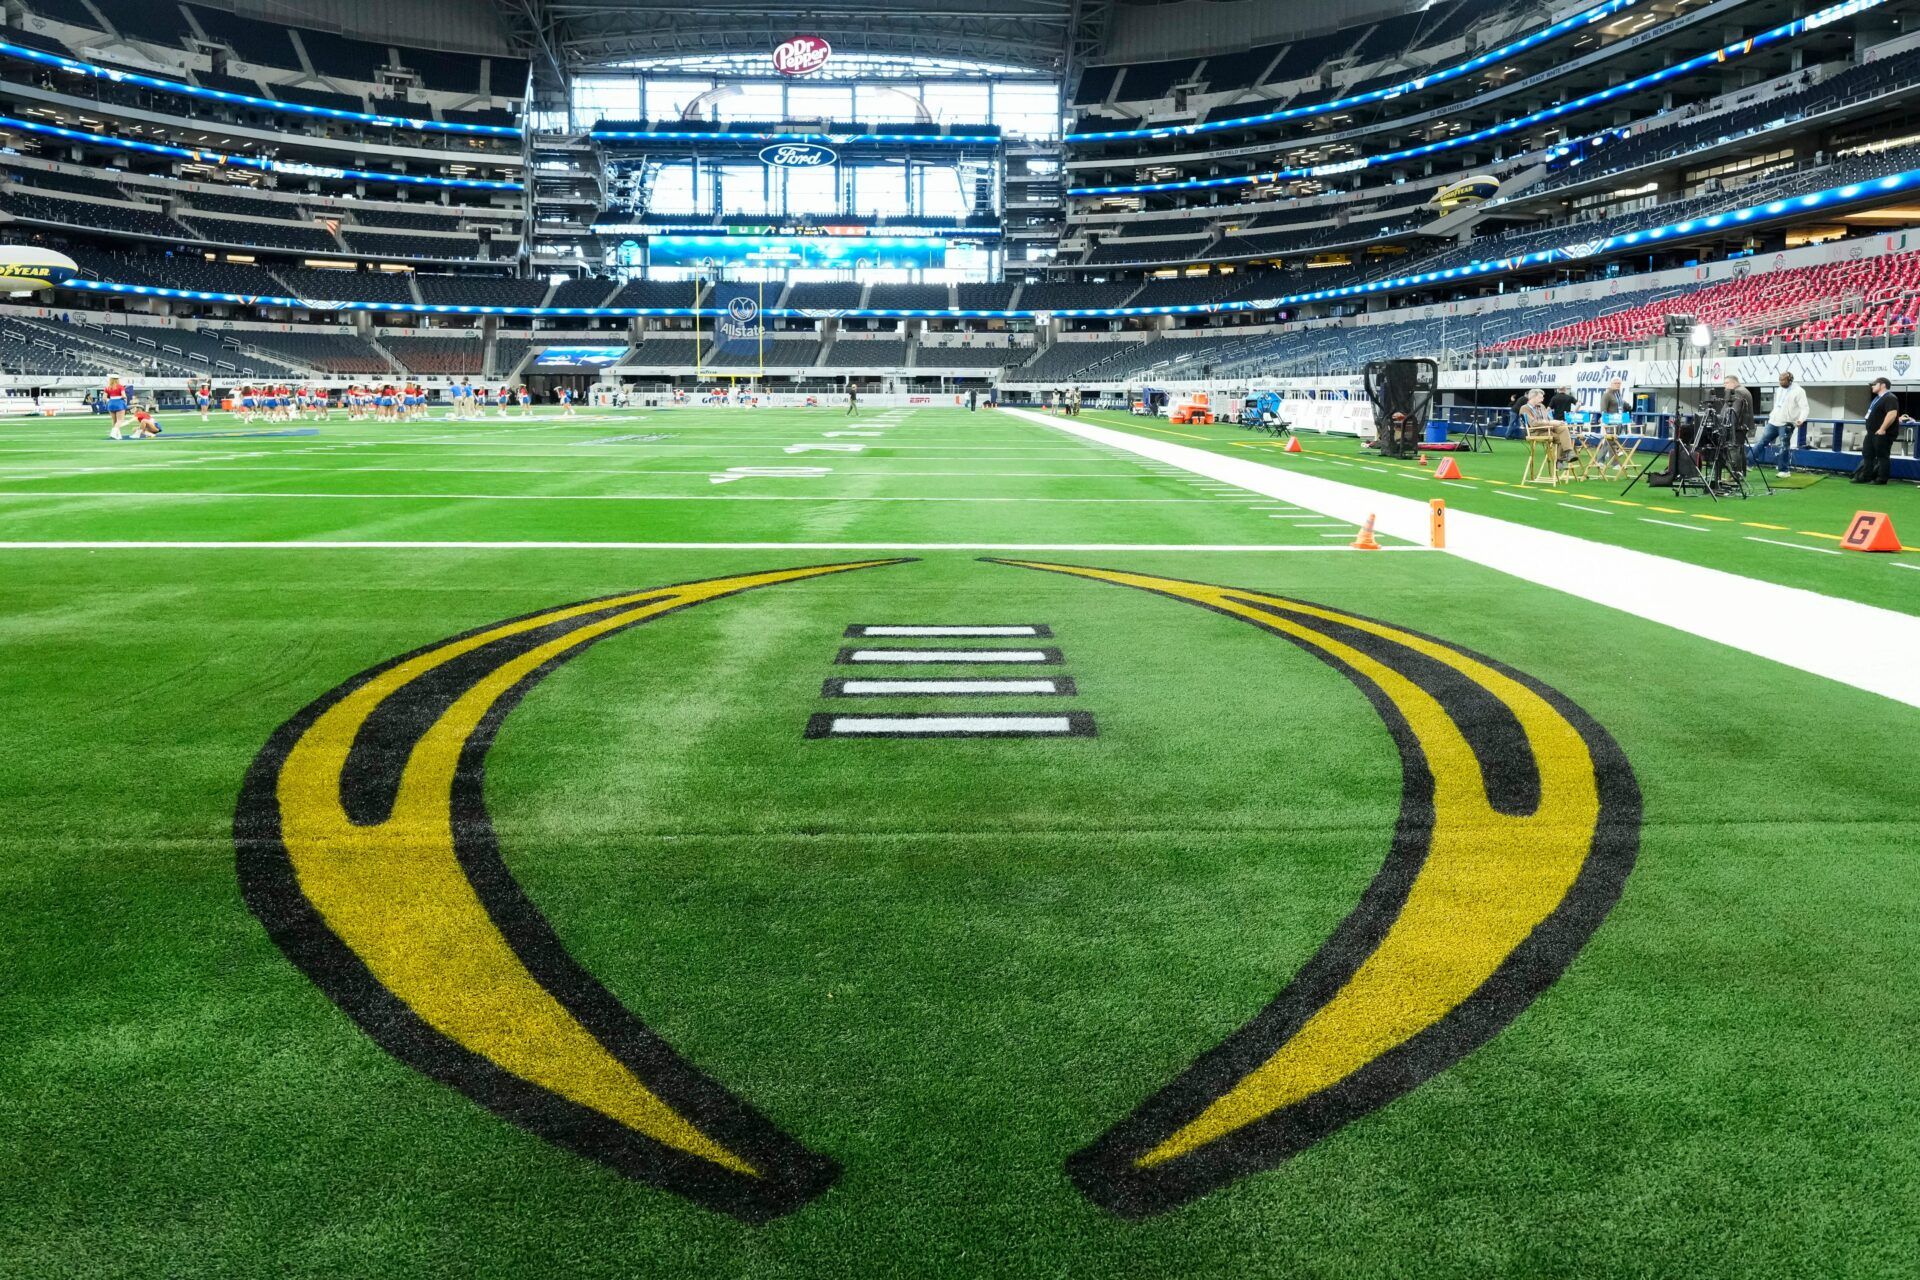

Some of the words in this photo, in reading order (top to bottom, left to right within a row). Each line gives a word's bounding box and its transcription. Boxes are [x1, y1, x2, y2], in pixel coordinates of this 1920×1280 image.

[1641, 33, 1651, 41] MEL
[1653, 22, 1675, 37] RENFRO
[793, 39, 815, 55] Dr
[779, 42, 828, 70] Pepper
[1546, 67, 1561, 78] WHITE
[773, 145, 822, 165] Ford
[720, 322, 766, 337] Allstate
[1520, 371, 1556, 384] GOODYEAR
[1577, 367, 1629, 383] GOODYEAR
[1847, 516, 1876, 544] G
